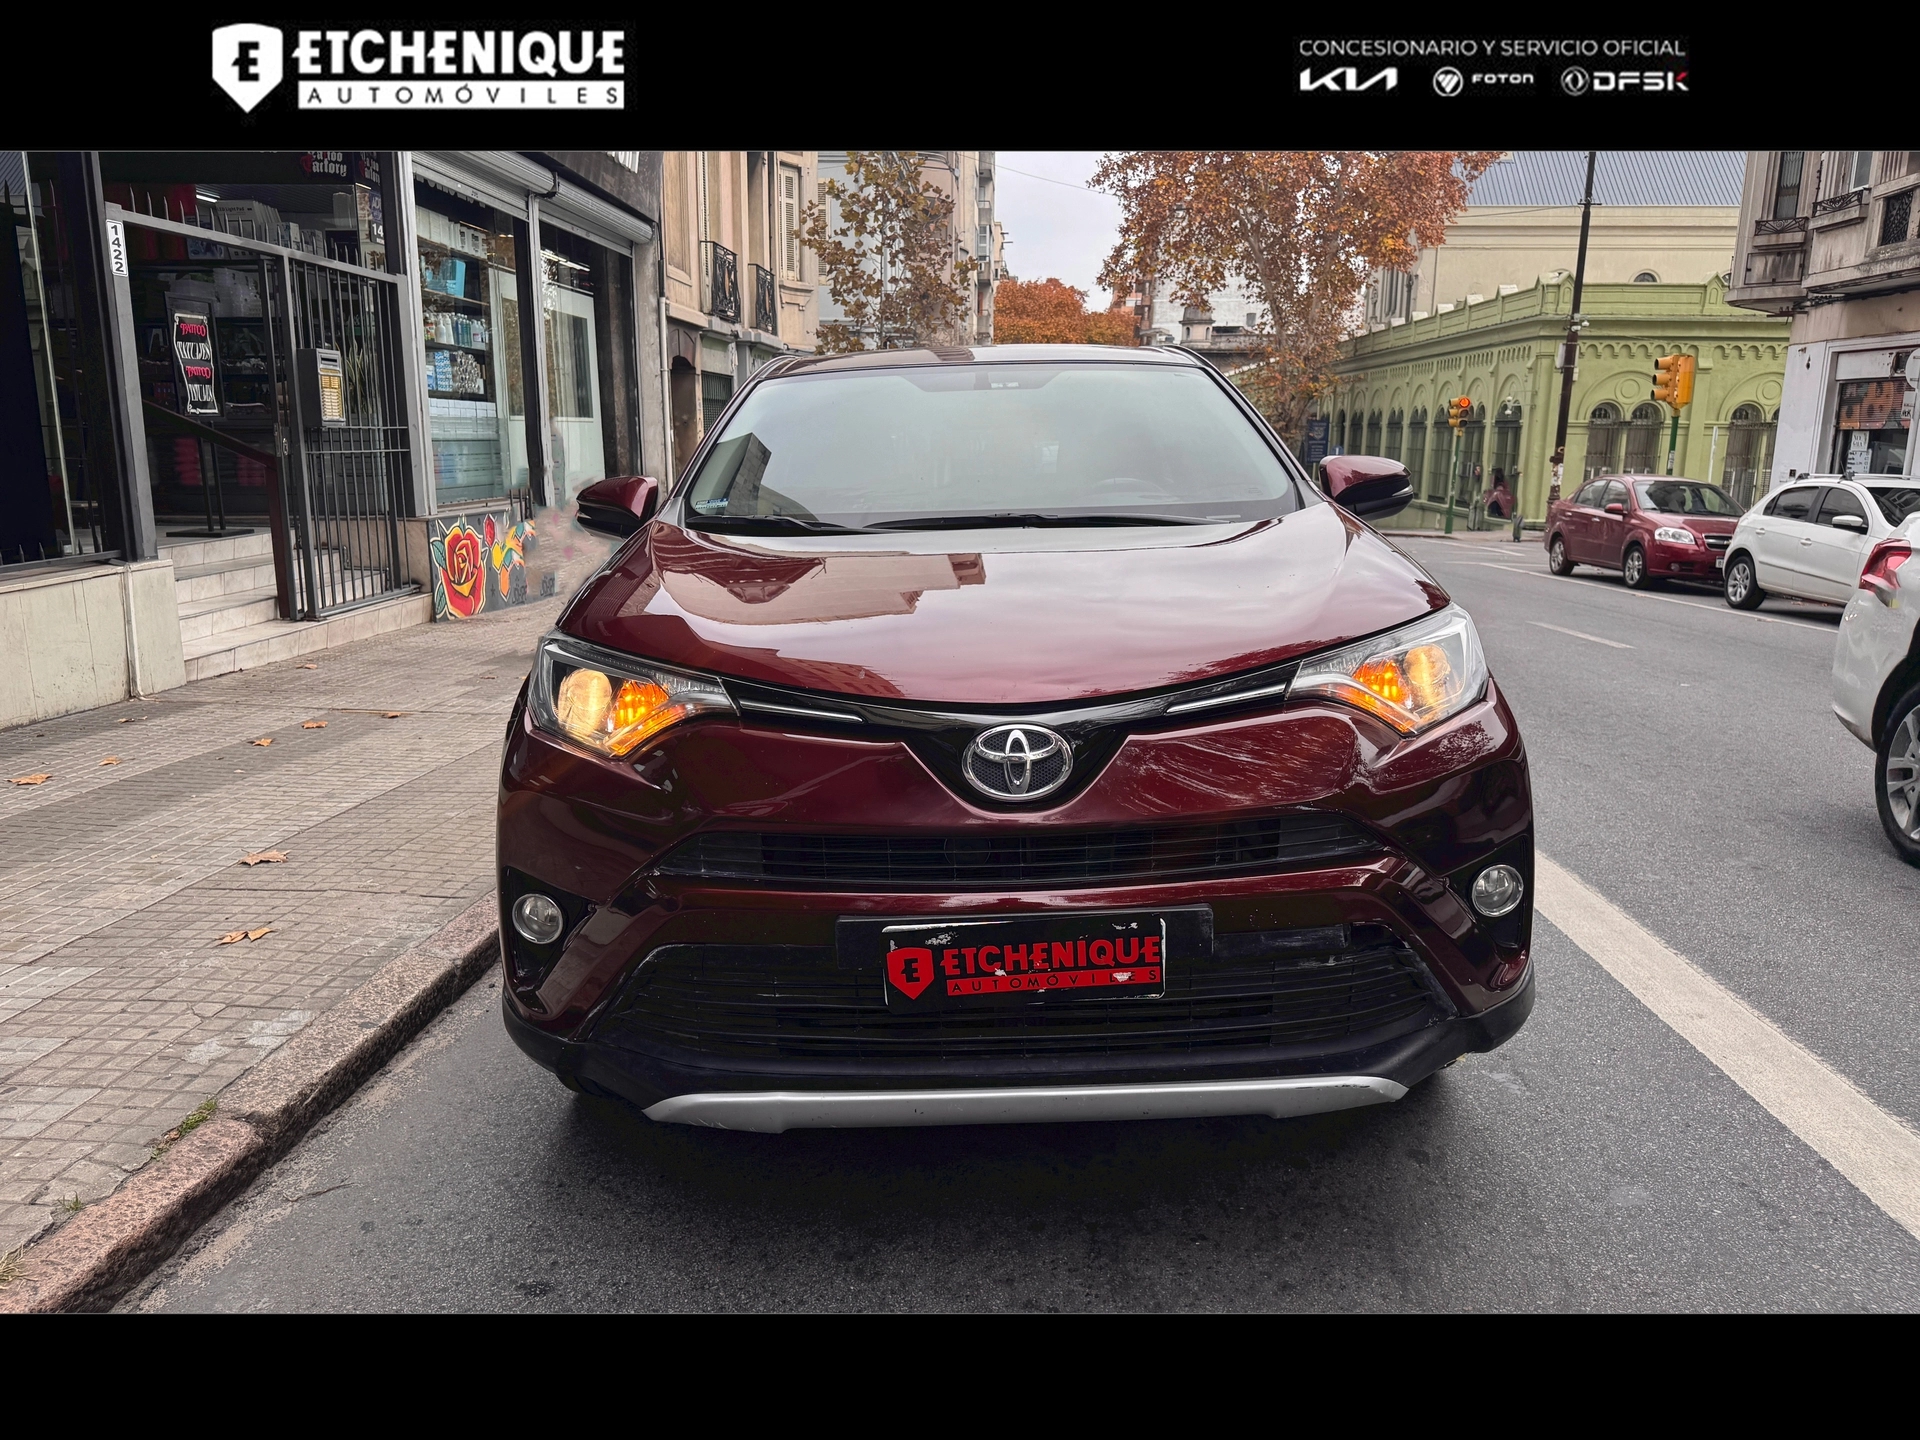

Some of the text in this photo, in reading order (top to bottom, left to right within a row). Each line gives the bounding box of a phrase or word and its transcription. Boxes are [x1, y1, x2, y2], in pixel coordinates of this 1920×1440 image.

[111, 224, 125, 273] 1422
[940, 936, 1160, 975] ETCHENIQUE
[951, 970, 1157, 993] AUTOMÓVILES
